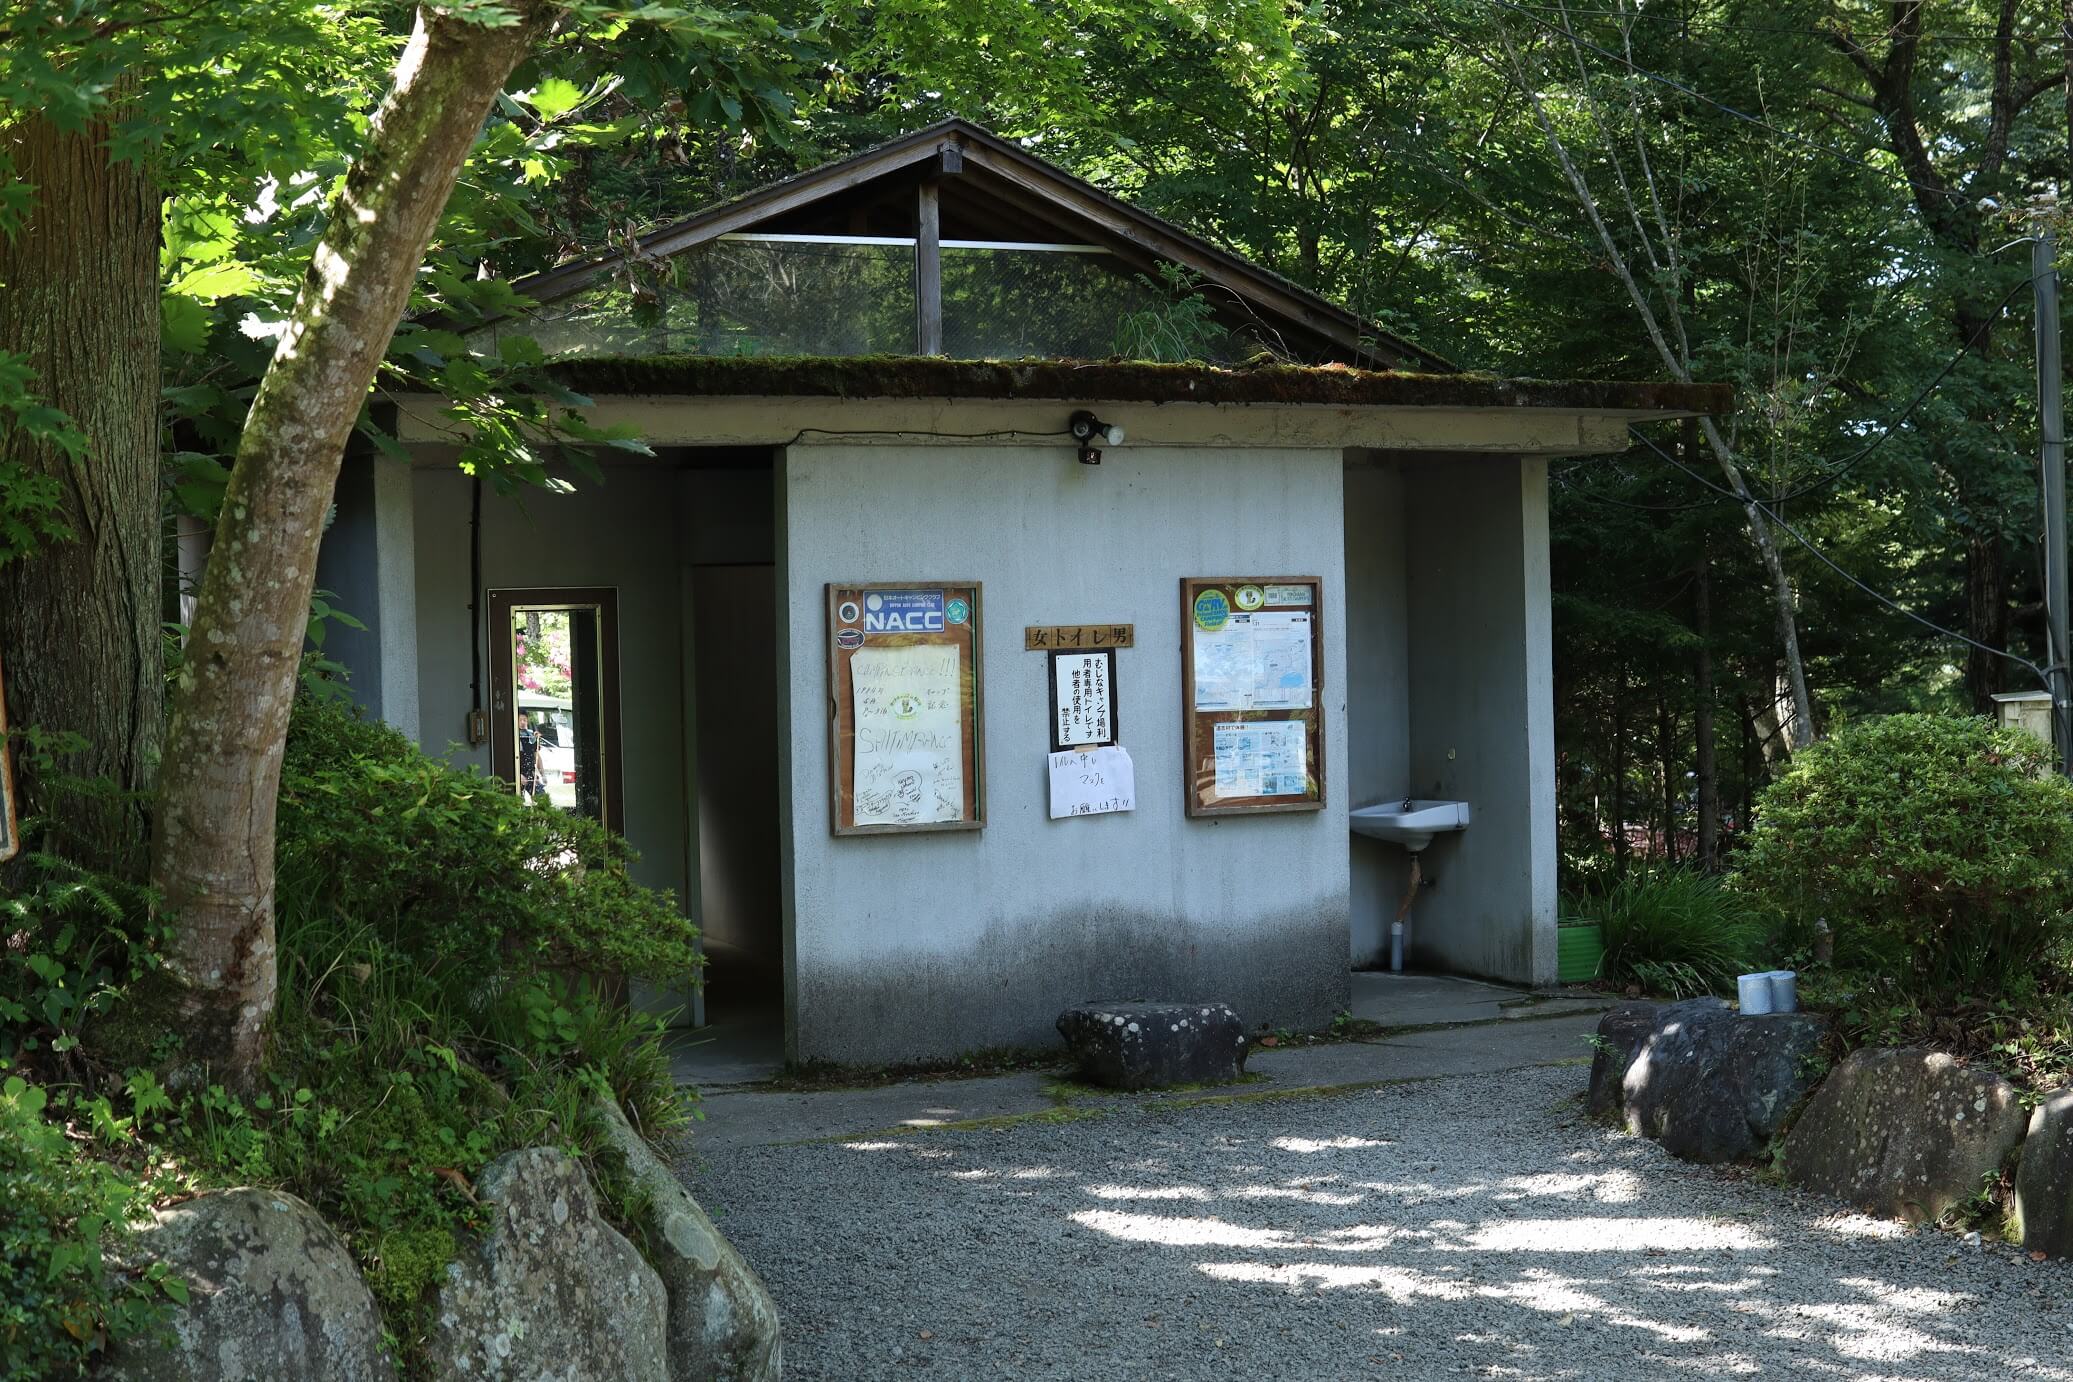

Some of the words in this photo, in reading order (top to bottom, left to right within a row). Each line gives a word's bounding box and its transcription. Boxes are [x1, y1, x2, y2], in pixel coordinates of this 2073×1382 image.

[1061, 707, 1071, 742] 禁止する
[1071, 669, 1081, 725] 他者の使用を
[1083, 658, 1093, 739] 用者専用トイレです
[1094, 657, 1106, 738] むじなキャンプ場利
